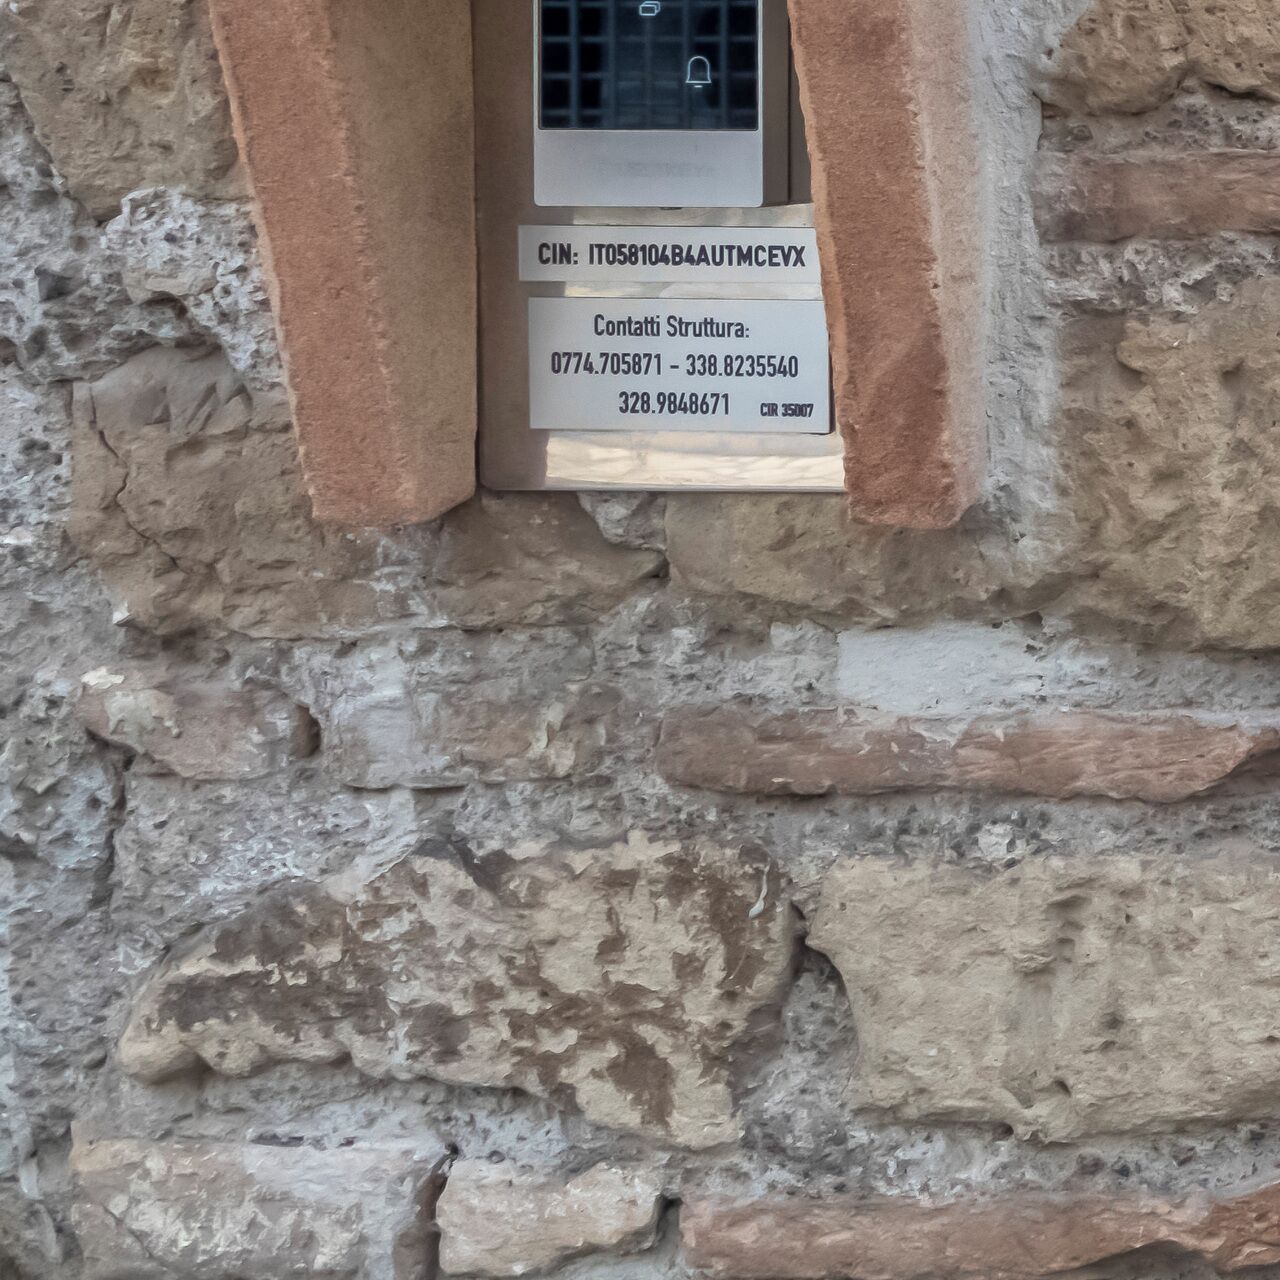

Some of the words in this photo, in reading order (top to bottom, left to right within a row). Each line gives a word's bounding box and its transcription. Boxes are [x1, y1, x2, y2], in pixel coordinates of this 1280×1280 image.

[537, 242, 579, 266] CIN:
[588, 242, 807, 268] IT058104B4AUTMCEVX
[593, 313, 661, 337] Contatti
[665, 314, 750, 338] Struttura:
[550, 351, 662, 376] 0774.705871
[685, 353, 799, 378] 338.8235540
[618, 390, 730, 416] 328.9848671
[759, 402, 780, 418] CIR
